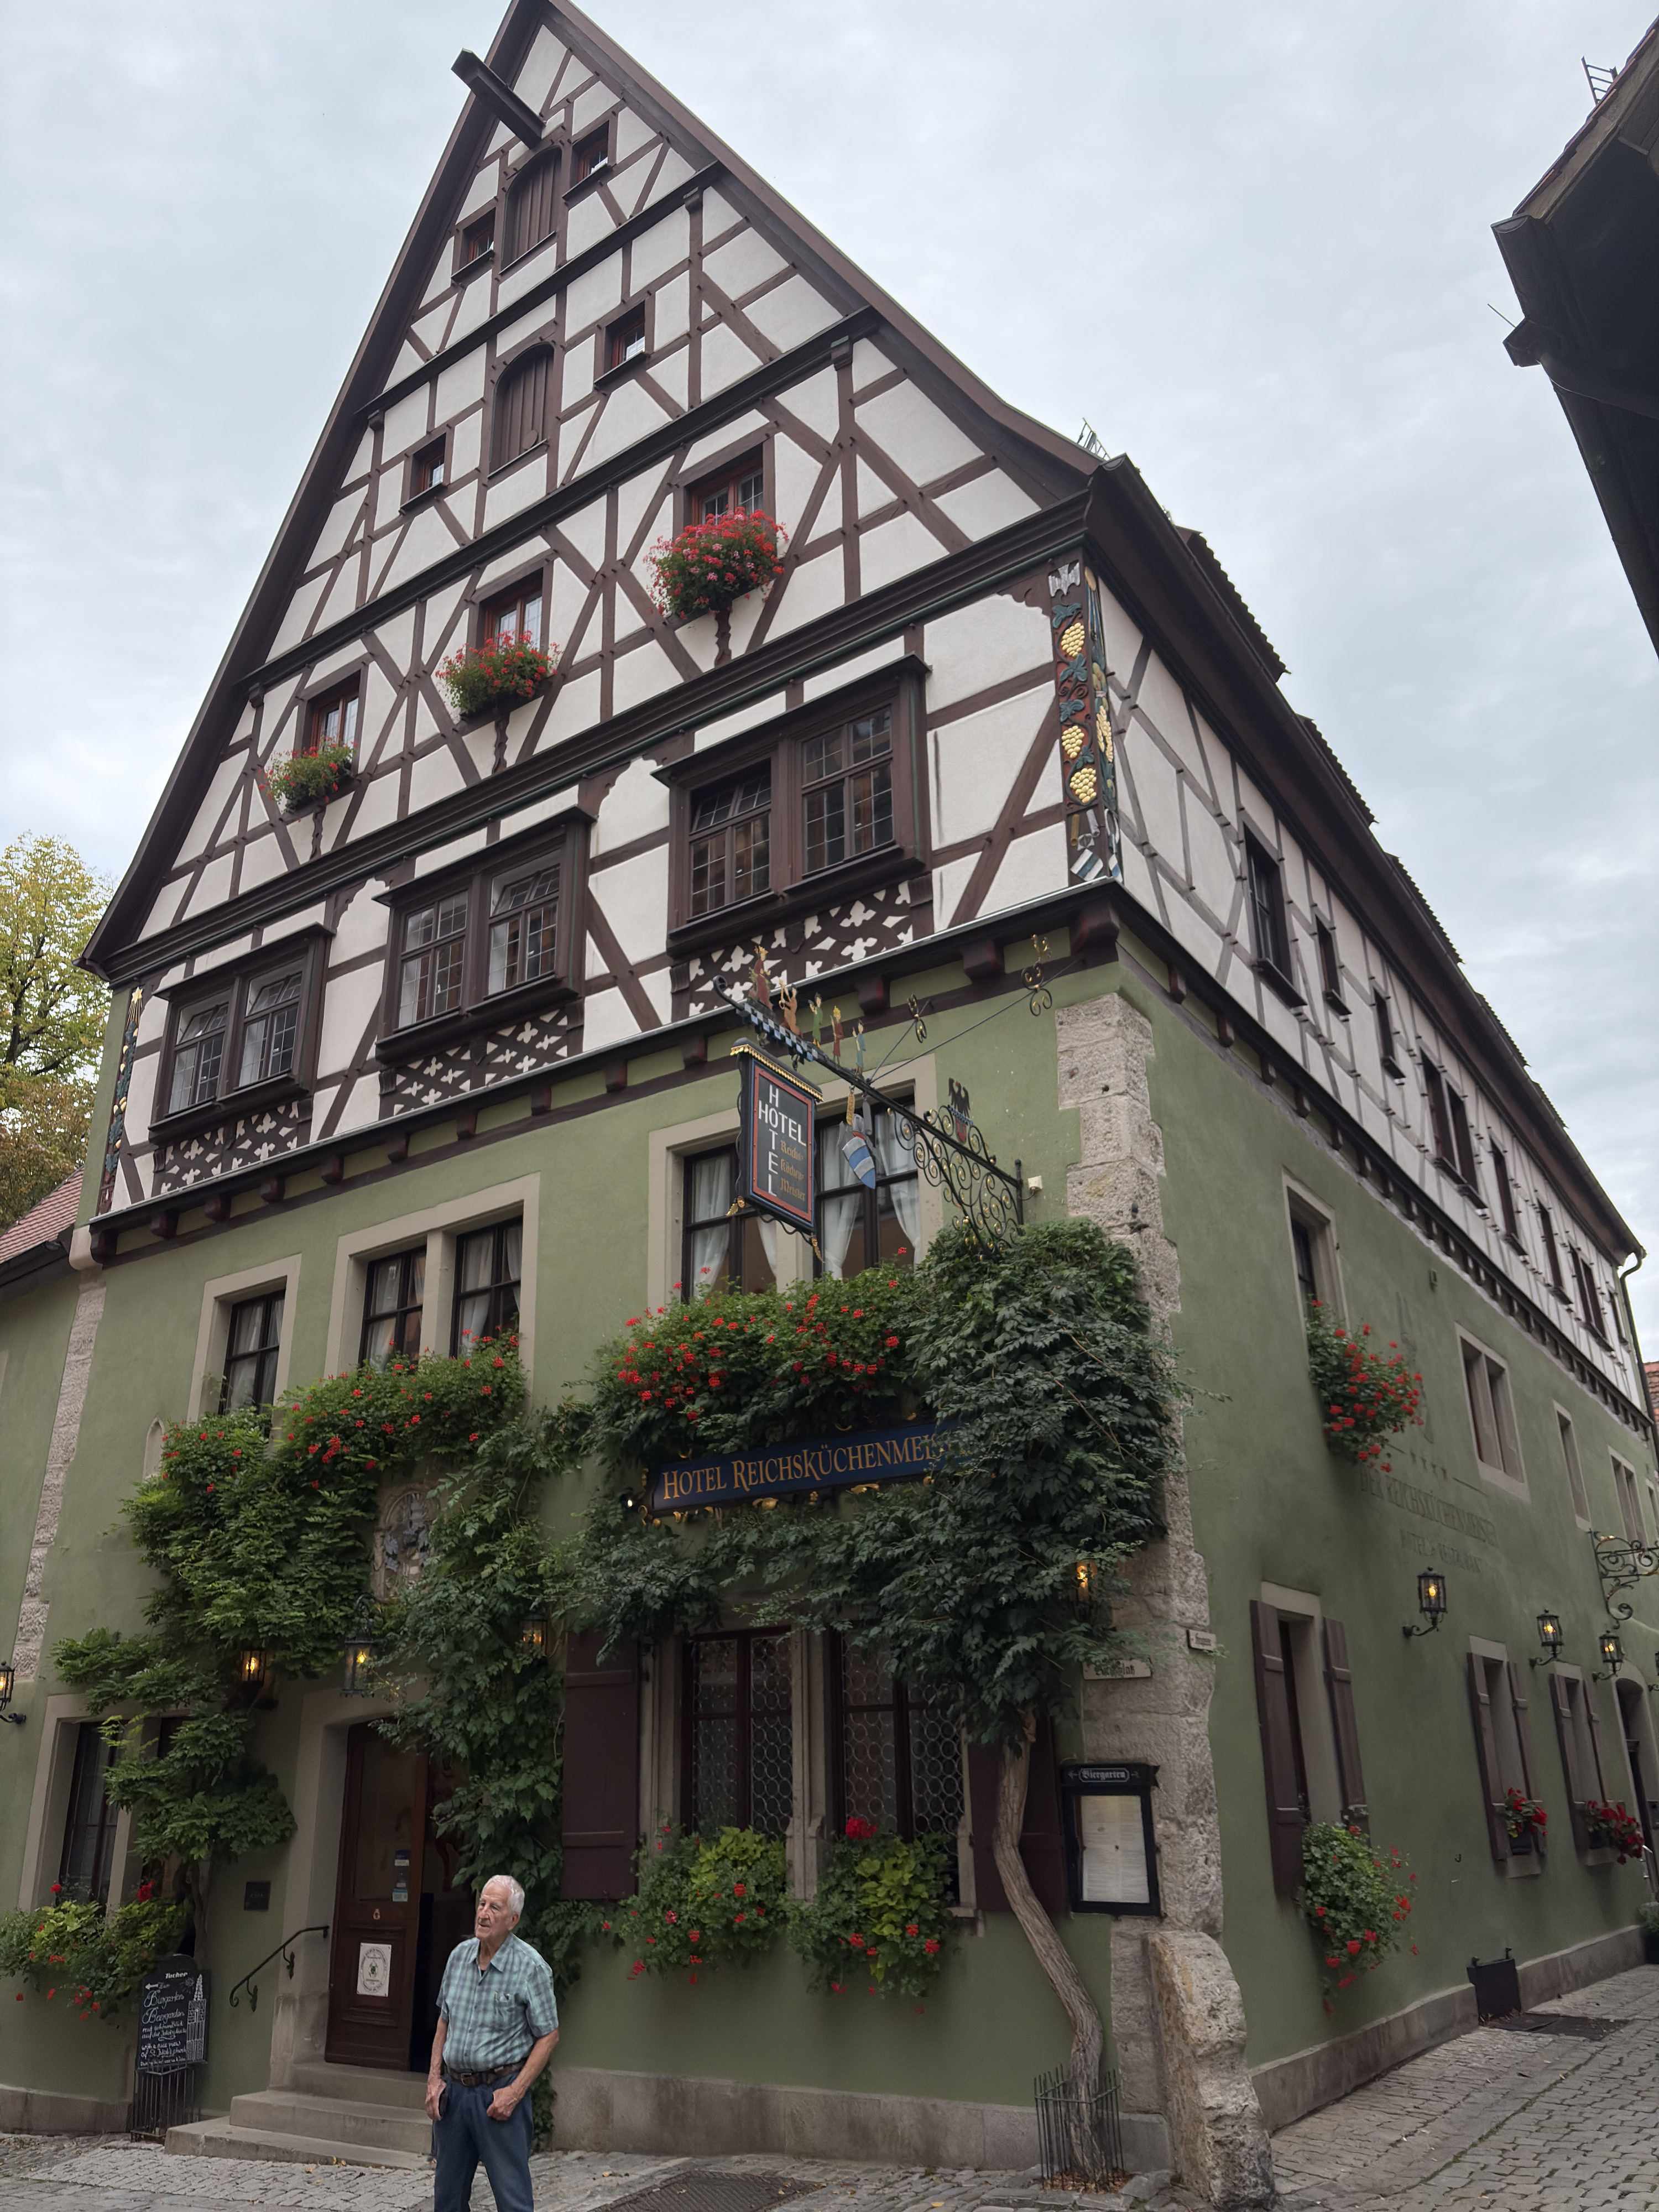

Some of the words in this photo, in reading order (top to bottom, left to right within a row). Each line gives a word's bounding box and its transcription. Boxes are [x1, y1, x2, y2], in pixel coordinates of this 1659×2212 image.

[758, 1099, 807, 1147] HOTEL
[768, 1084, 779, 1197] HOTEL
[662, 1467, 727, 1500] HOTEL
[731, 1430, 972, 1492] REICHSKÜCHENMEI
[1082, 1769, 1126, 1780] Biergarten
